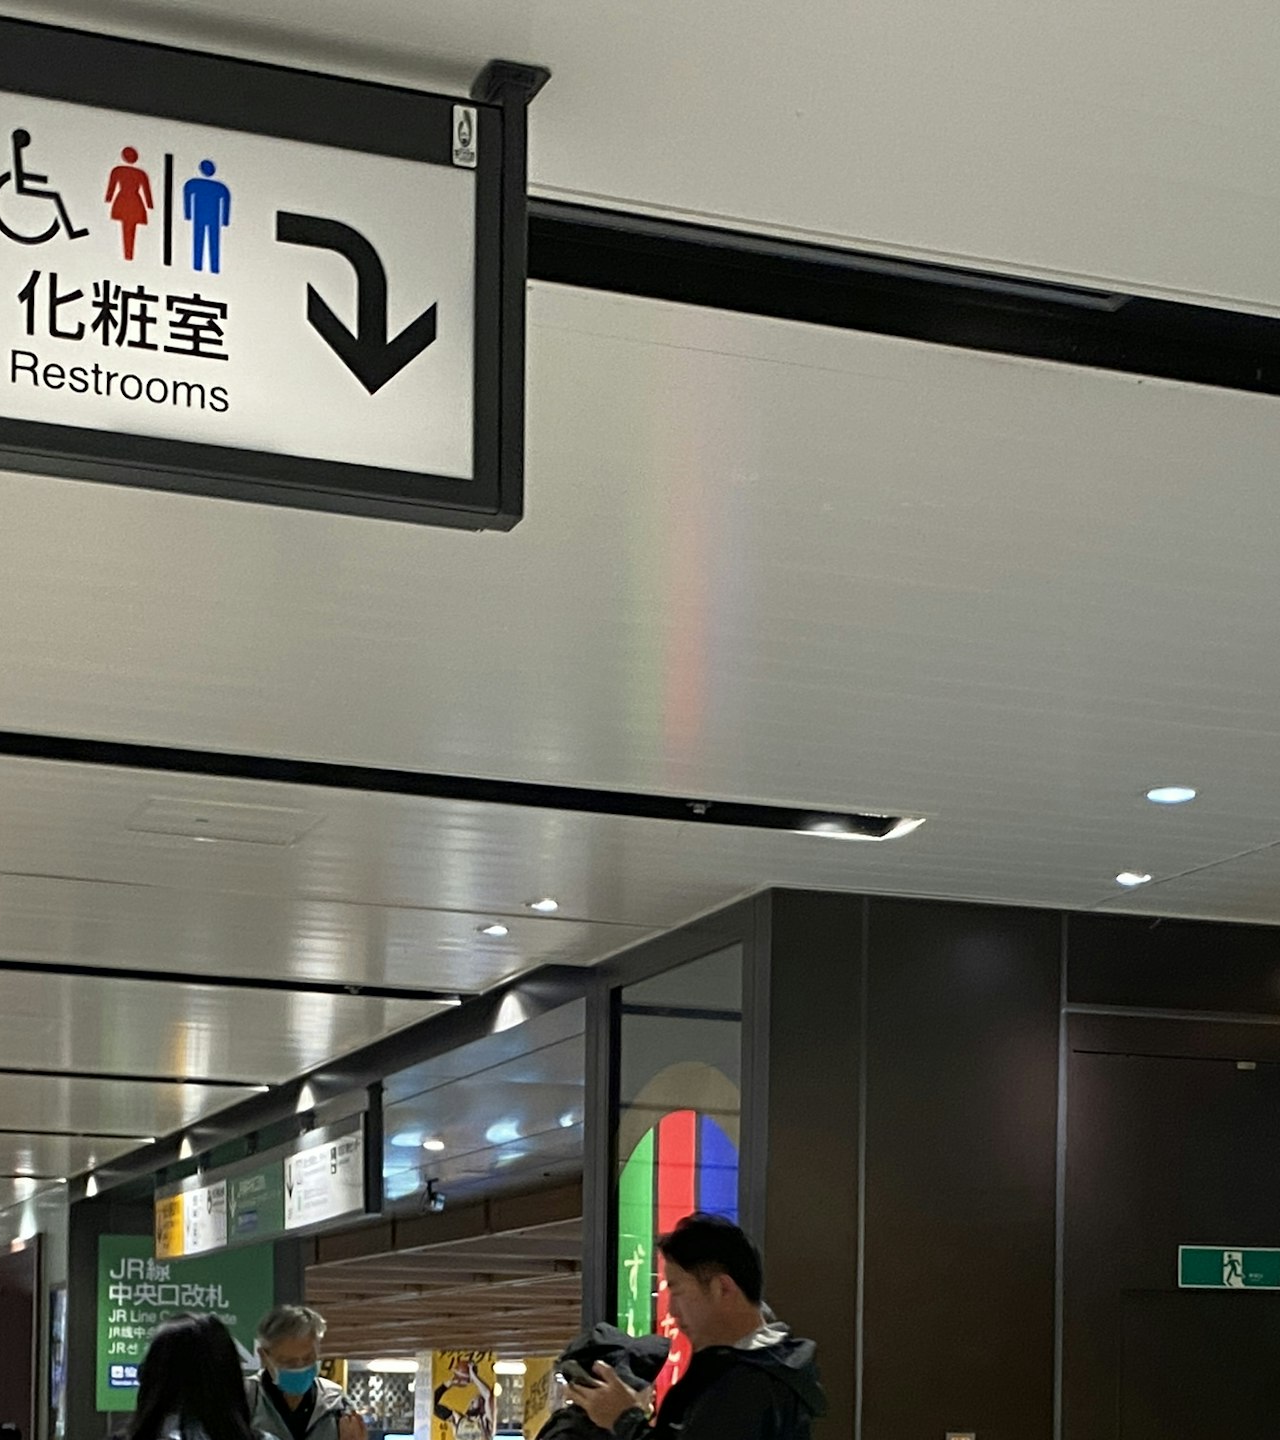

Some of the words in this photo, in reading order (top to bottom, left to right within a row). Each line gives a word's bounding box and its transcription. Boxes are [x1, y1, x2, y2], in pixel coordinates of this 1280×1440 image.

[17, 268, 230, 362] 化粧室
[9, 349, 230, 414] Restrooms
[108, 1282, 230, 1309] 中央口改札
[108, 1308, 128, 1323] JR
[129, 1309, 157, 1323] Line
